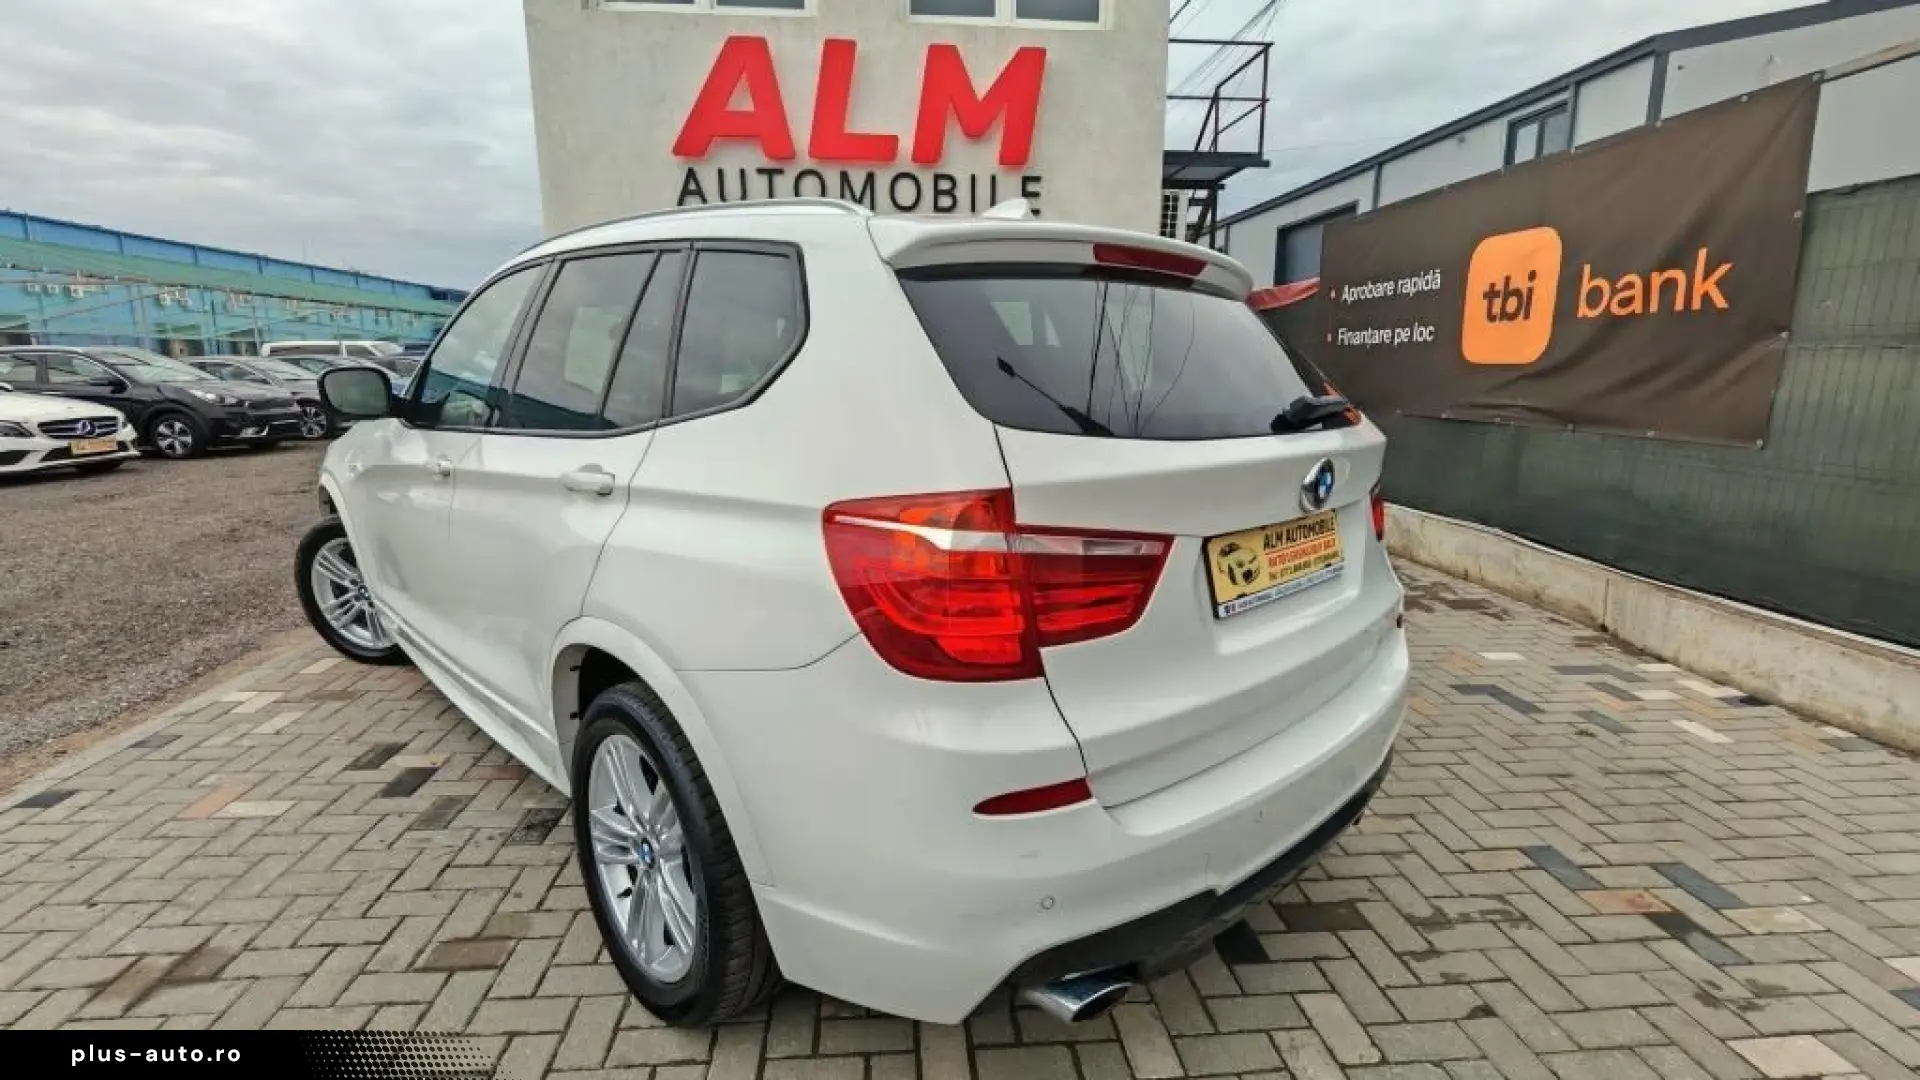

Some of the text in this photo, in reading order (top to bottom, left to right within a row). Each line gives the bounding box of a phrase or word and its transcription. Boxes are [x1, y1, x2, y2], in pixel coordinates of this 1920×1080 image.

[672, 35, 1047, 166] ALM
[676, 166, 1043, 216] AUTOMOBILE
[1341, 269, 1440, 304] Aprobare rapidă
[1483, 247, 1734, 322] tbi bank
[1394, 327, 1411, 346] pe
[1413, 322, 1435, 342] loc
